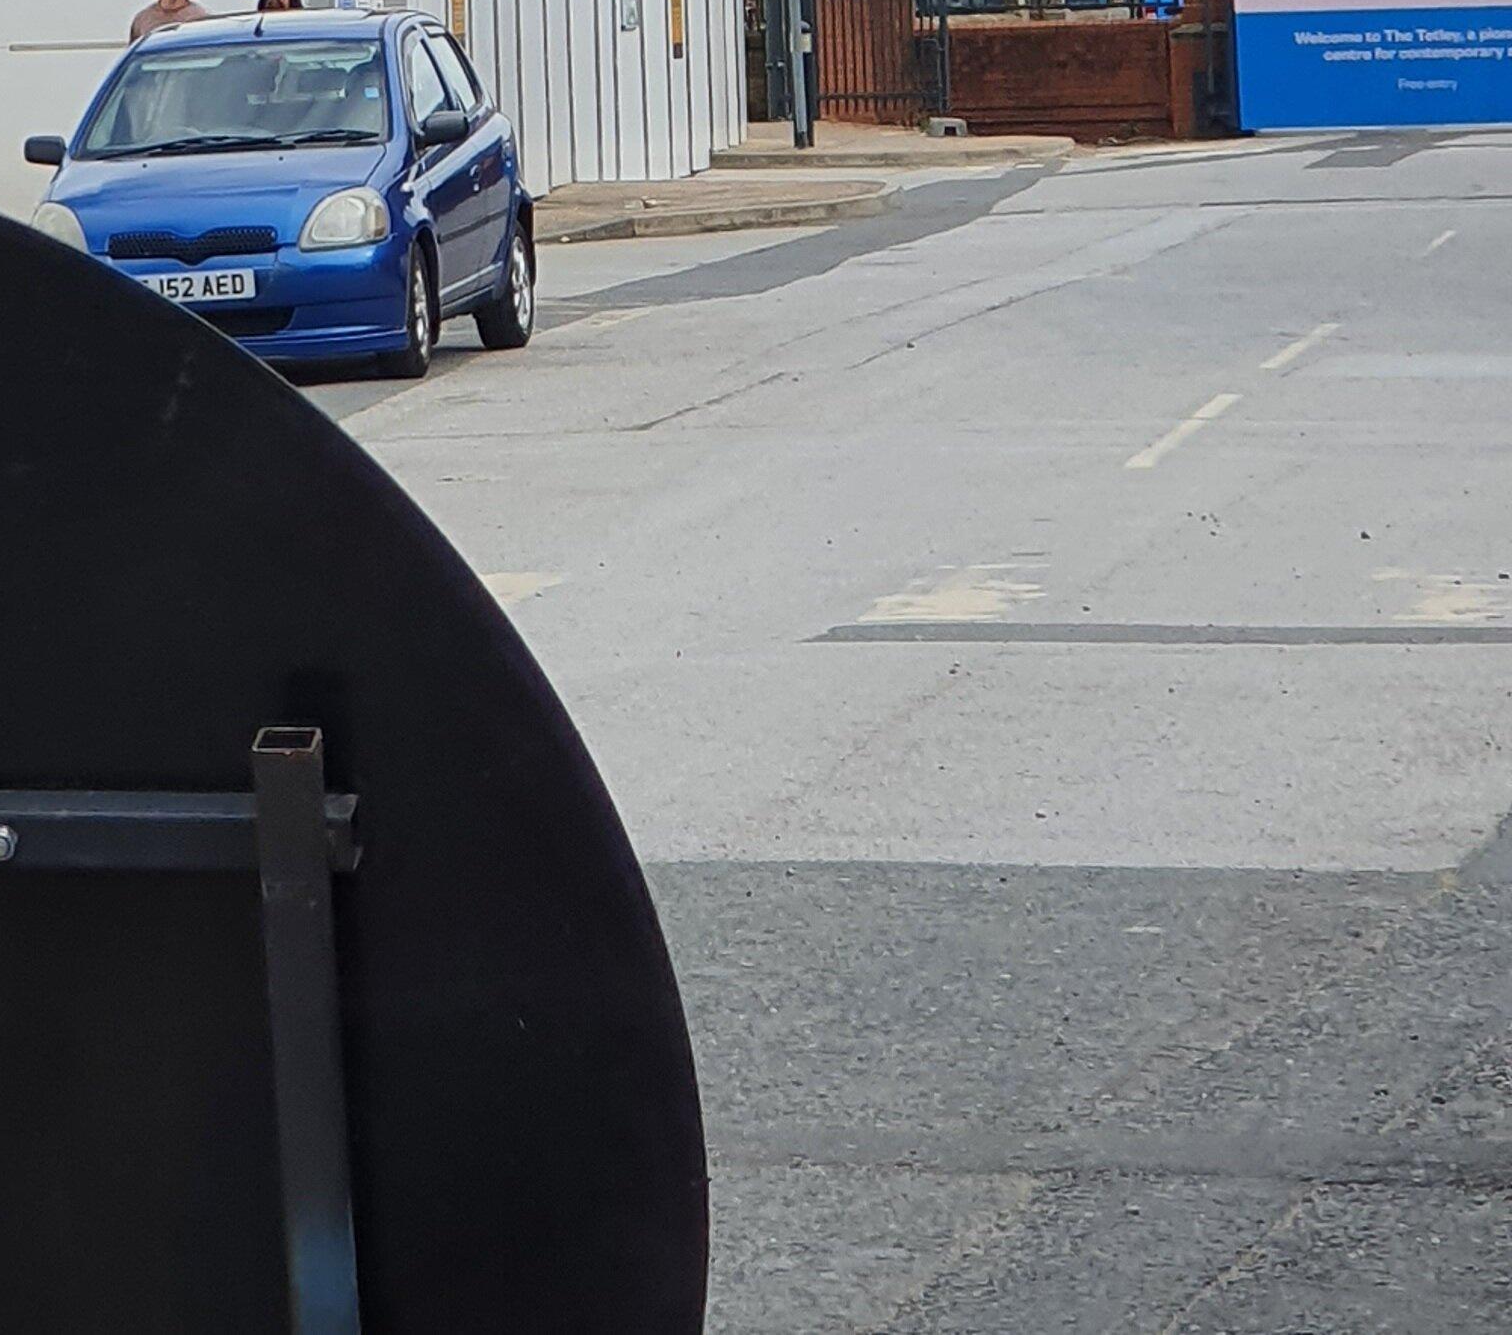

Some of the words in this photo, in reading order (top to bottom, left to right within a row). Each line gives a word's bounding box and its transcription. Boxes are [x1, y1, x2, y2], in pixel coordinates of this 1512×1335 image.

[1294, 31, 1364, 45] Welcome
[1365, 32, 1381, 43] to
[1383, 29, 1413, 42] The
[1323, 49, 1372, 61] centre
[1374, 47, 1396, 60] for
[1398, 47, 1504, 61] contemporary
[202, 273, 245, 296] AED
